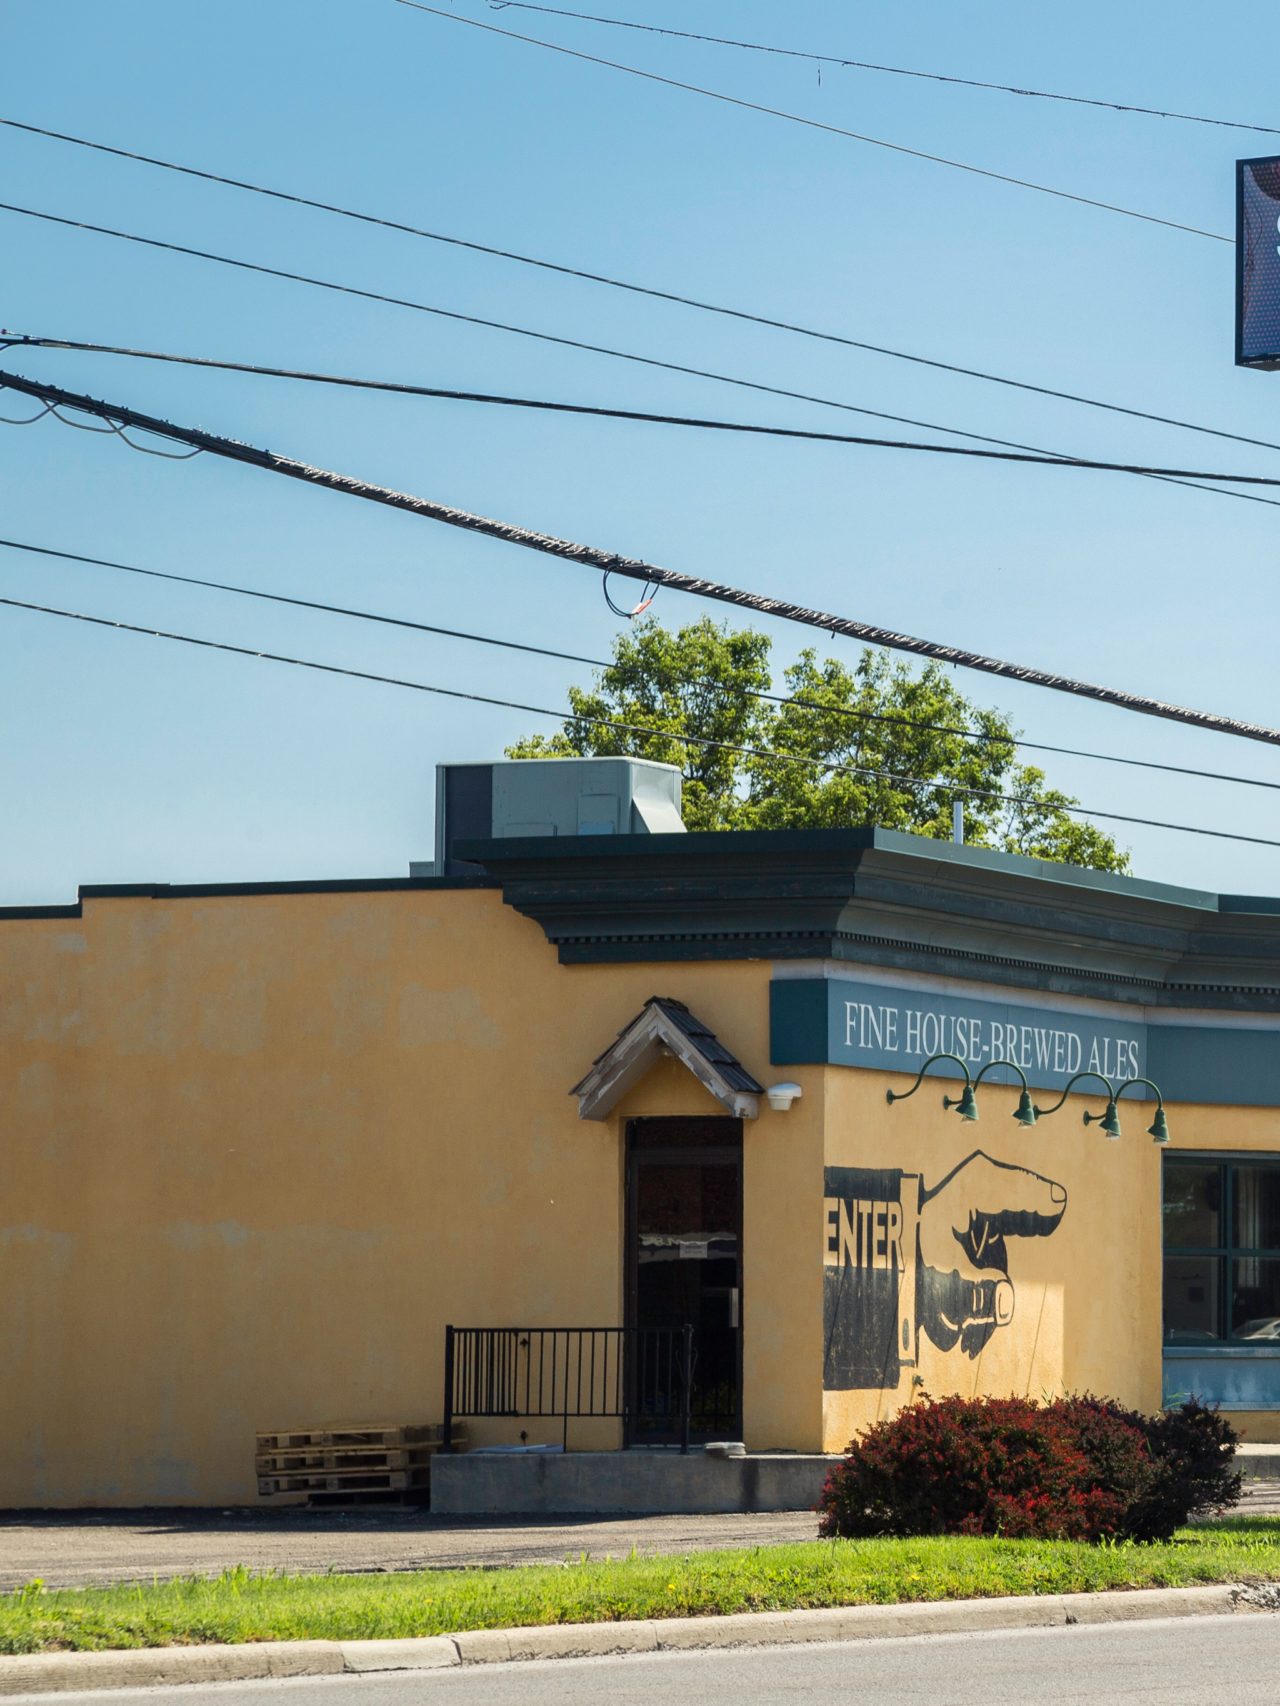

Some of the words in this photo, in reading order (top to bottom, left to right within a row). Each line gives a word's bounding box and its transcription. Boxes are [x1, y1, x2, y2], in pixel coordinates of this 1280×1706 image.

[844, 1001, 898, 1051] FINE
[905, 1010, 1081, 1074] HOUSE-BREWED
[1088, 1036, 1139, 1081] ALES
[823, 1197, 905, 1272] ENTER
